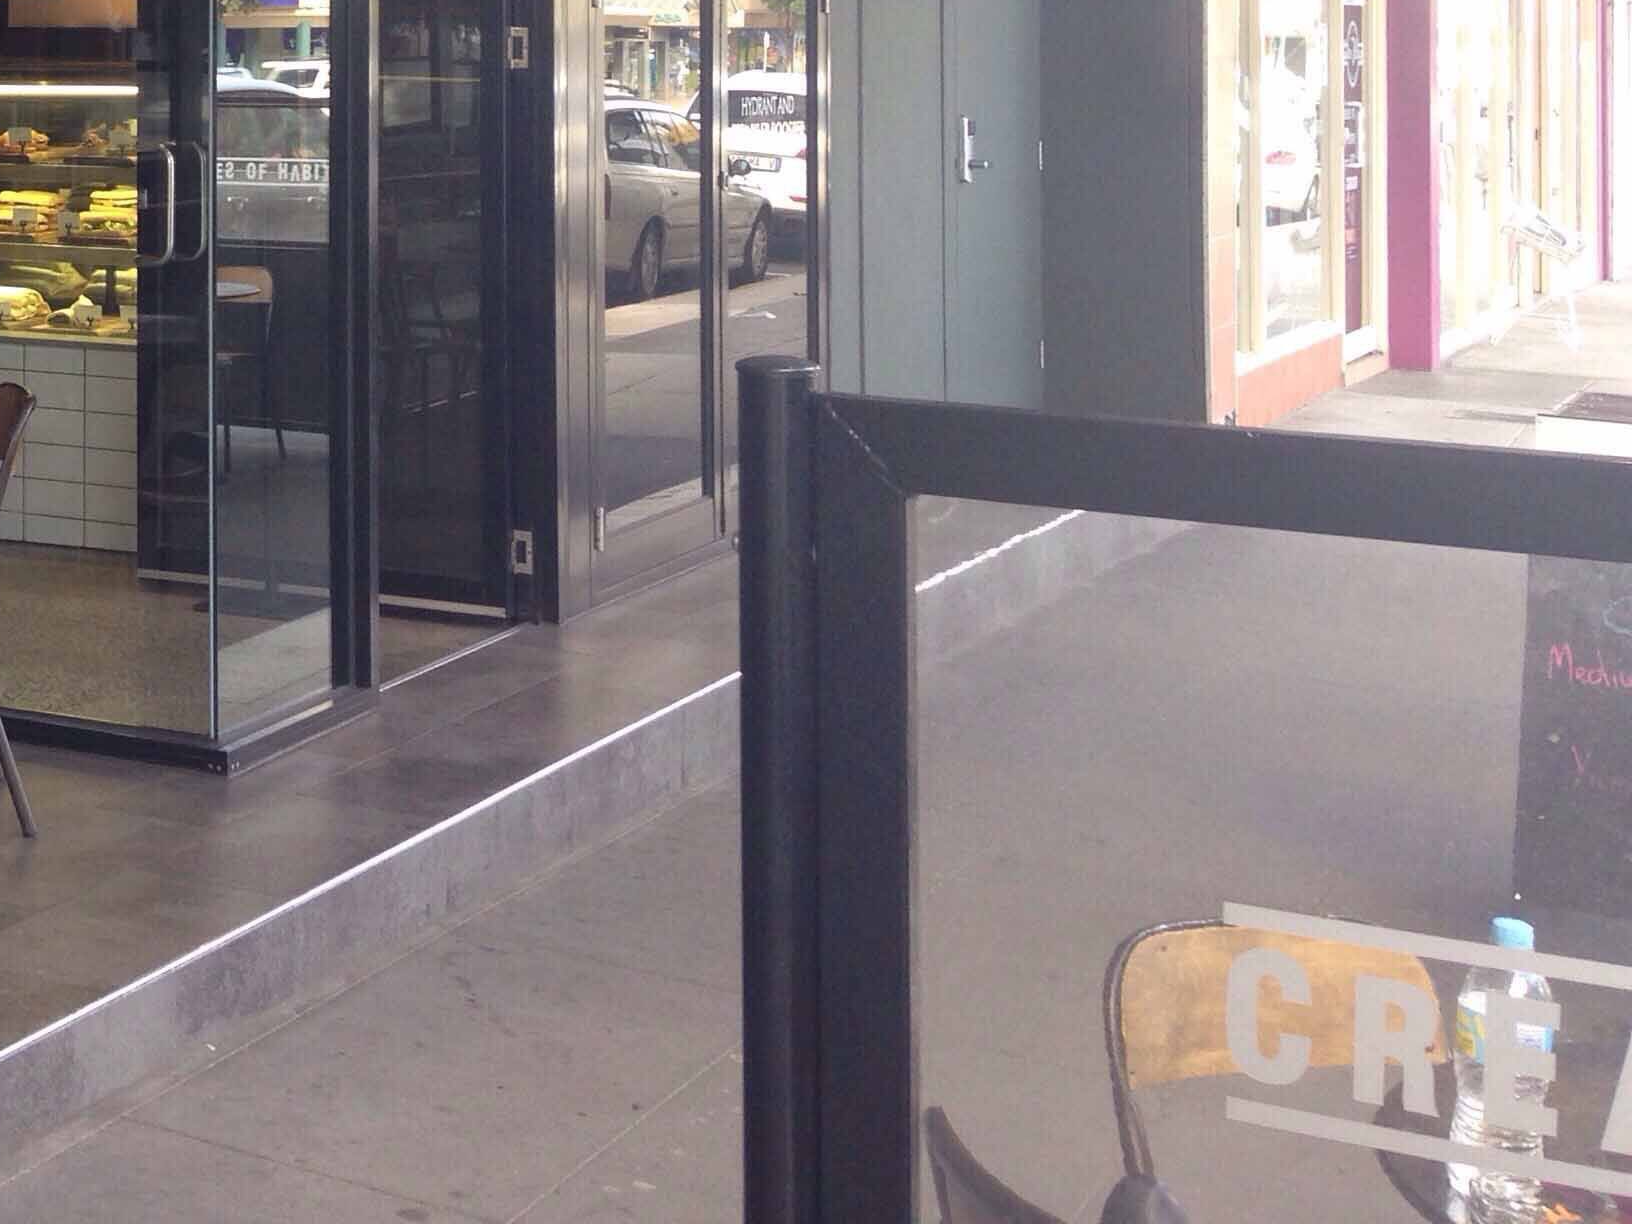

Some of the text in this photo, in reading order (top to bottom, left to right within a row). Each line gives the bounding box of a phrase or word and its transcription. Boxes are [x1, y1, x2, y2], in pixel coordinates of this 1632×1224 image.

[741, 95, 795, 117] HYDRANT AND
[246, 161, 268, 181] OF
